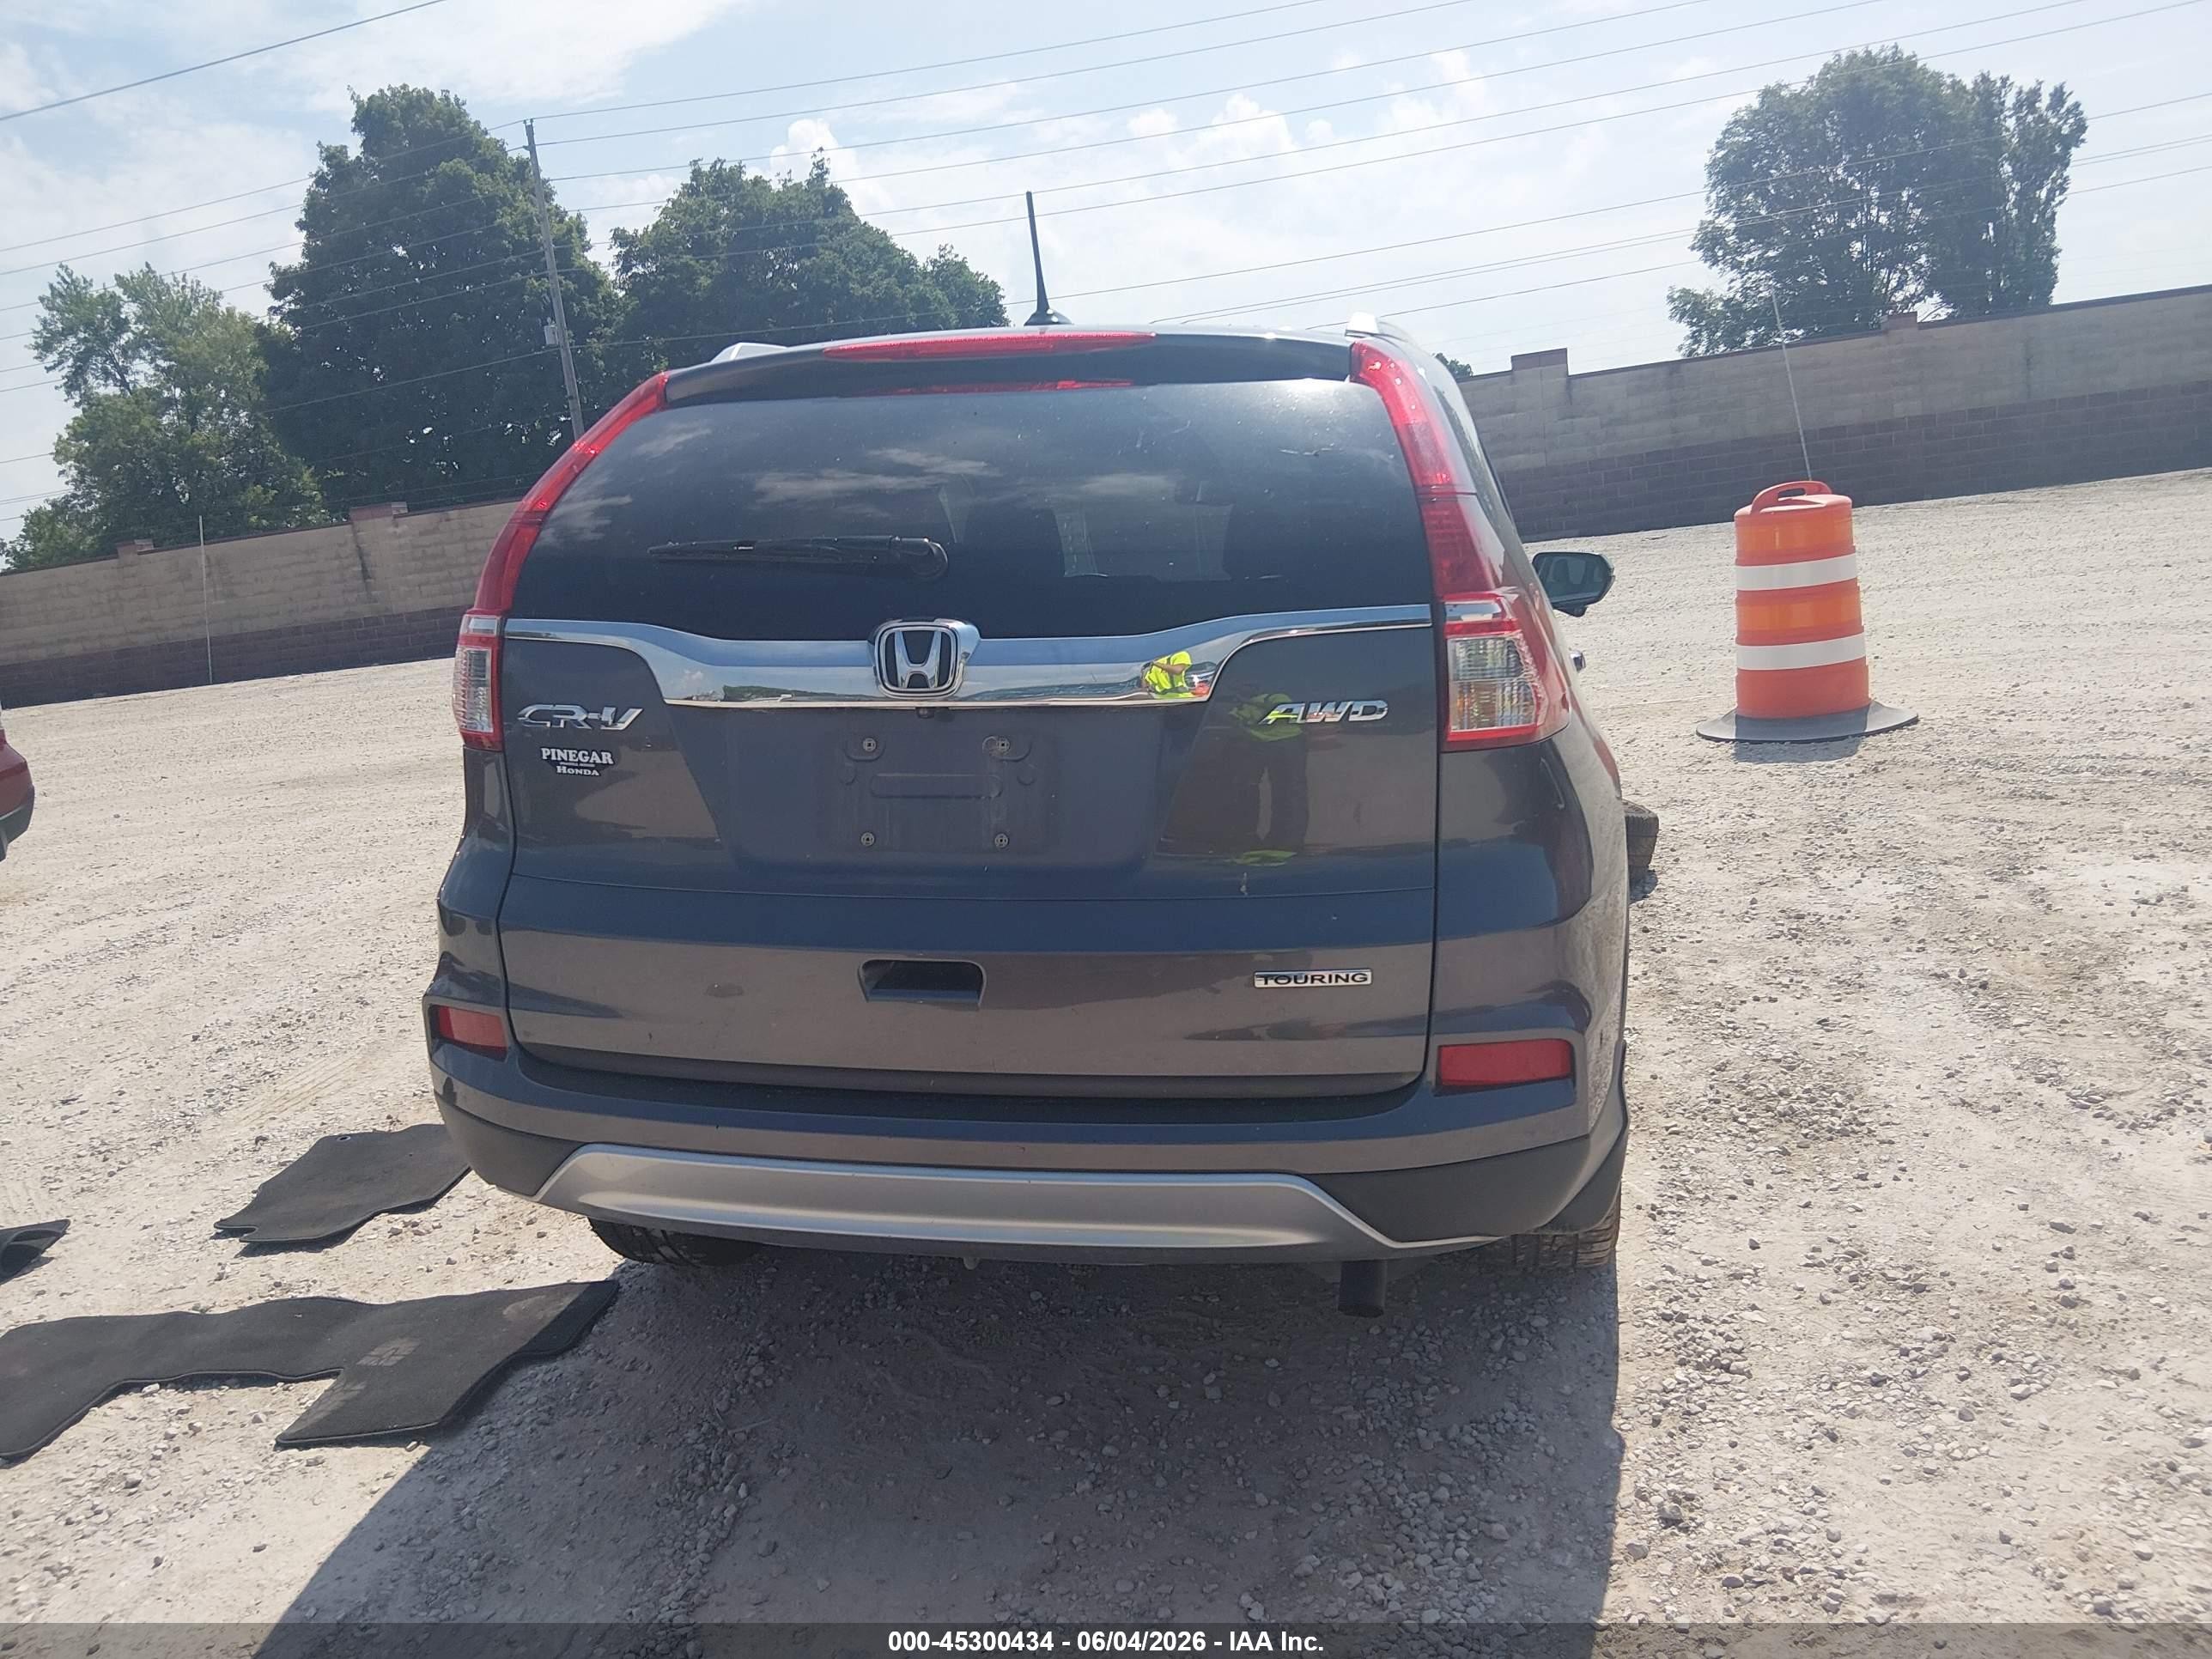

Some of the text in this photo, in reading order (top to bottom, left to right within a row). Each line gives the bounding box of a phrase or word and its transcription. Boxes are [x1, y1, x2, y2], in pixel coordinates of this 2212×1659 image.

[517, 704, 643, 730] CR-V
[1258, 700, 1389, 725] AWD
[541, 747, 614, 764] PINEGAR
[1256, 973, 1368, 985] TOURING
